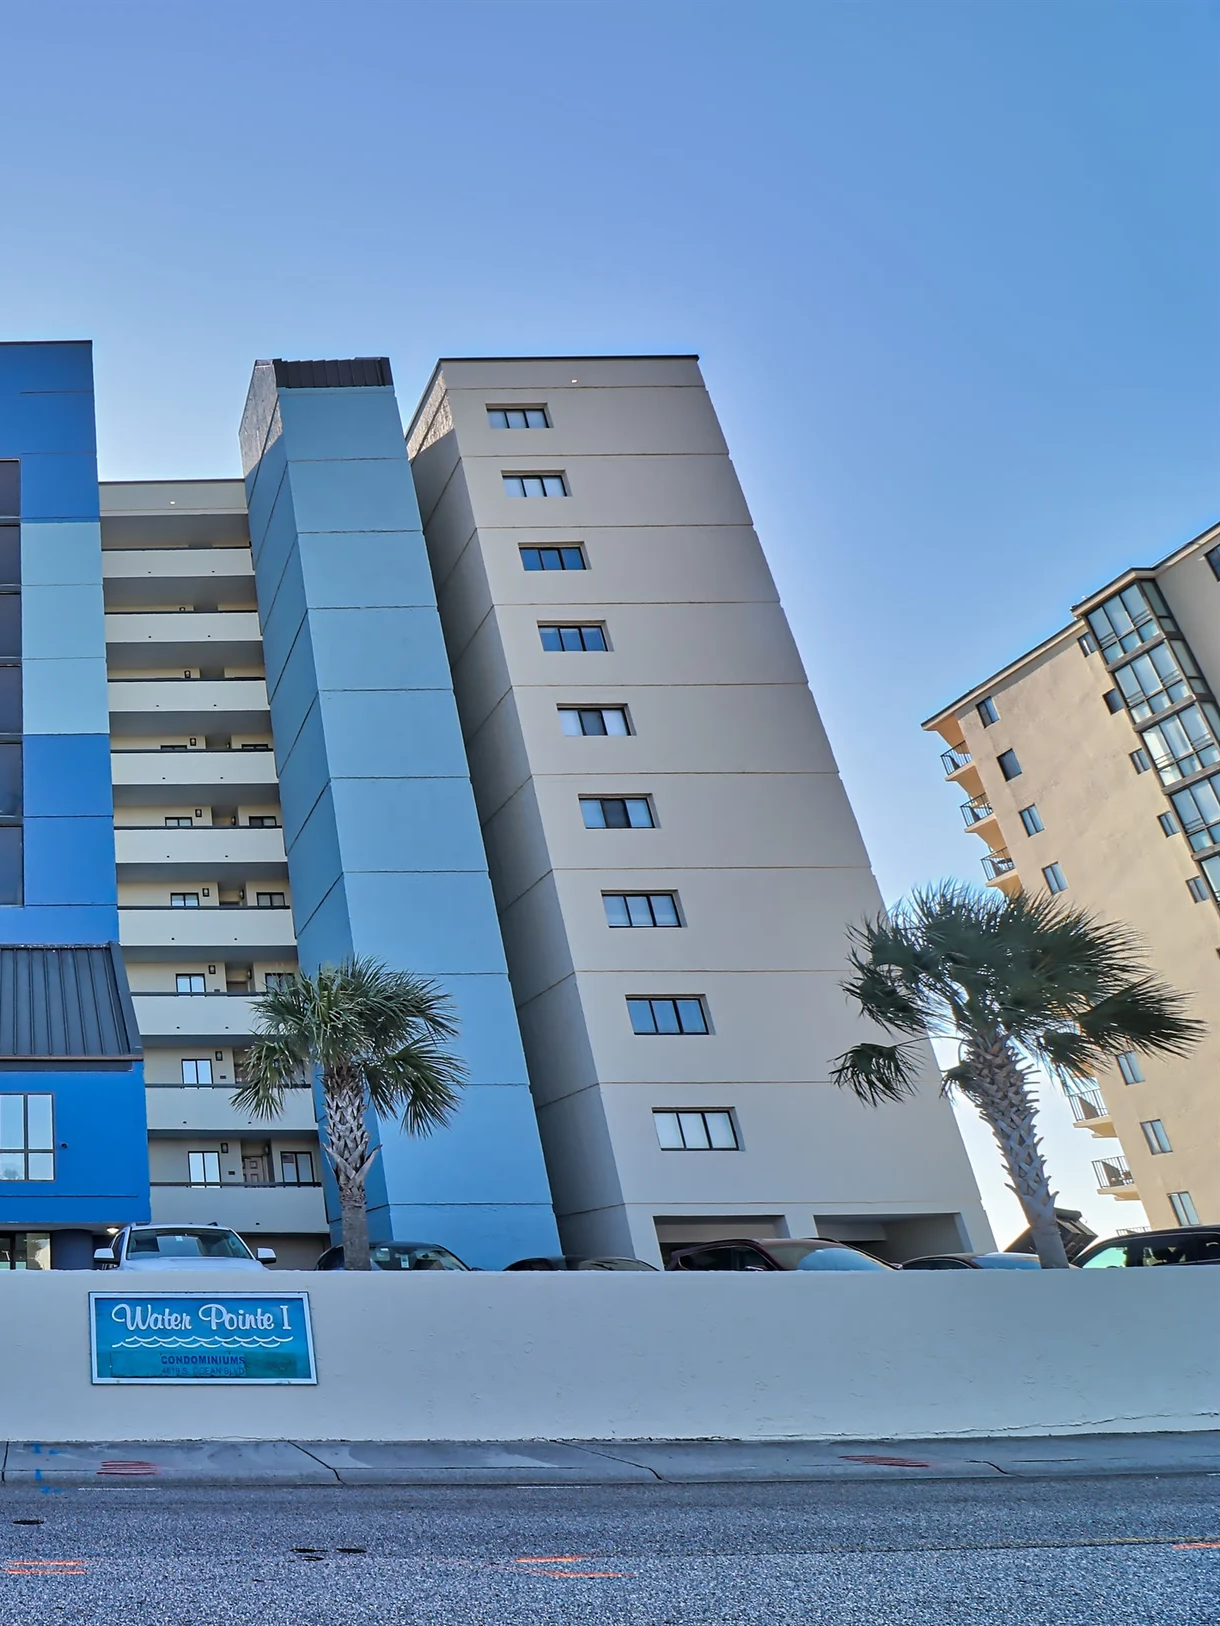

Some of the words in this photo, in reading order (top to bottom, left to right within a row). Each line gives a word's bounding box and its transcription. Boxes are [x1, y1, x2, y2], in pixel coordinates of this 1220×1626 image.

[111, 1303, 192, 1331] Water
[198, 1303, 275, 1330] Pointe
[280, 1305, 292, 1330] I
[161, 1355, 245, 1365] CONDOMINIUMS
[192, 1366, 222, 1375] OCEAN
